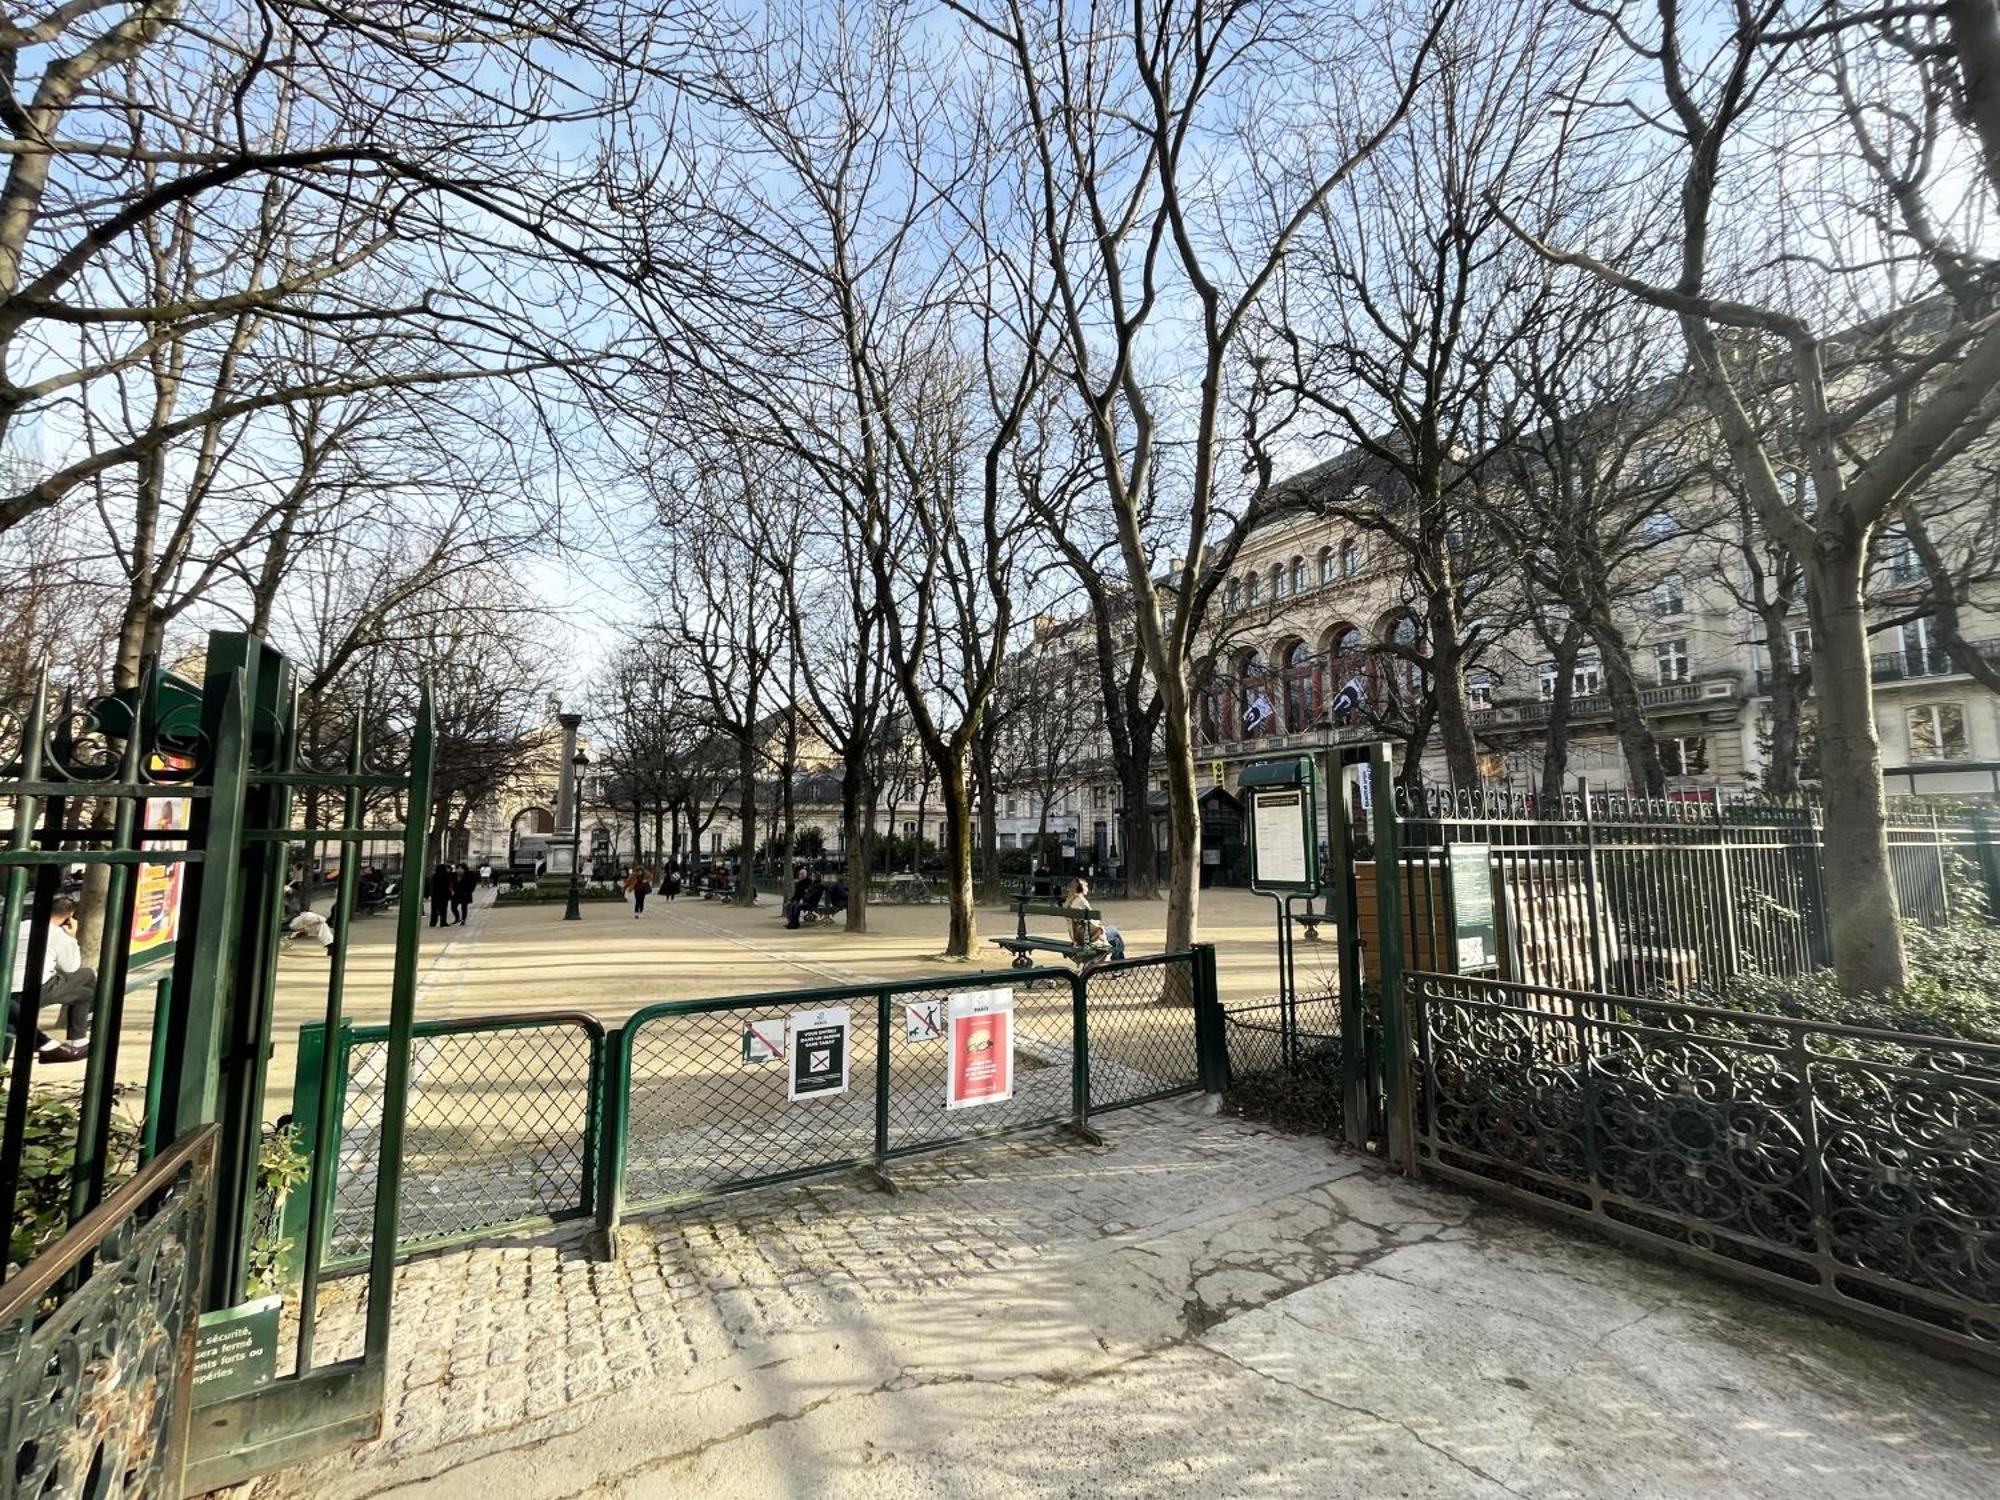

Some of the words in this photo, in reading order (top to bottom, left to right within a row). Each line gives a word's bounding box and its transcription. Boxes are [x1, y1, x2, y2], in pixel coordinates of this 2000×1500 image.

[206, 1327, 252, 1344] sécurité,
[222, 1337, 253, 1353] fermé
[193, 1360, 217, 1371] ents
[221, 1352, 246, 1365] forts
[249, 1348, 264, 1357] ou
